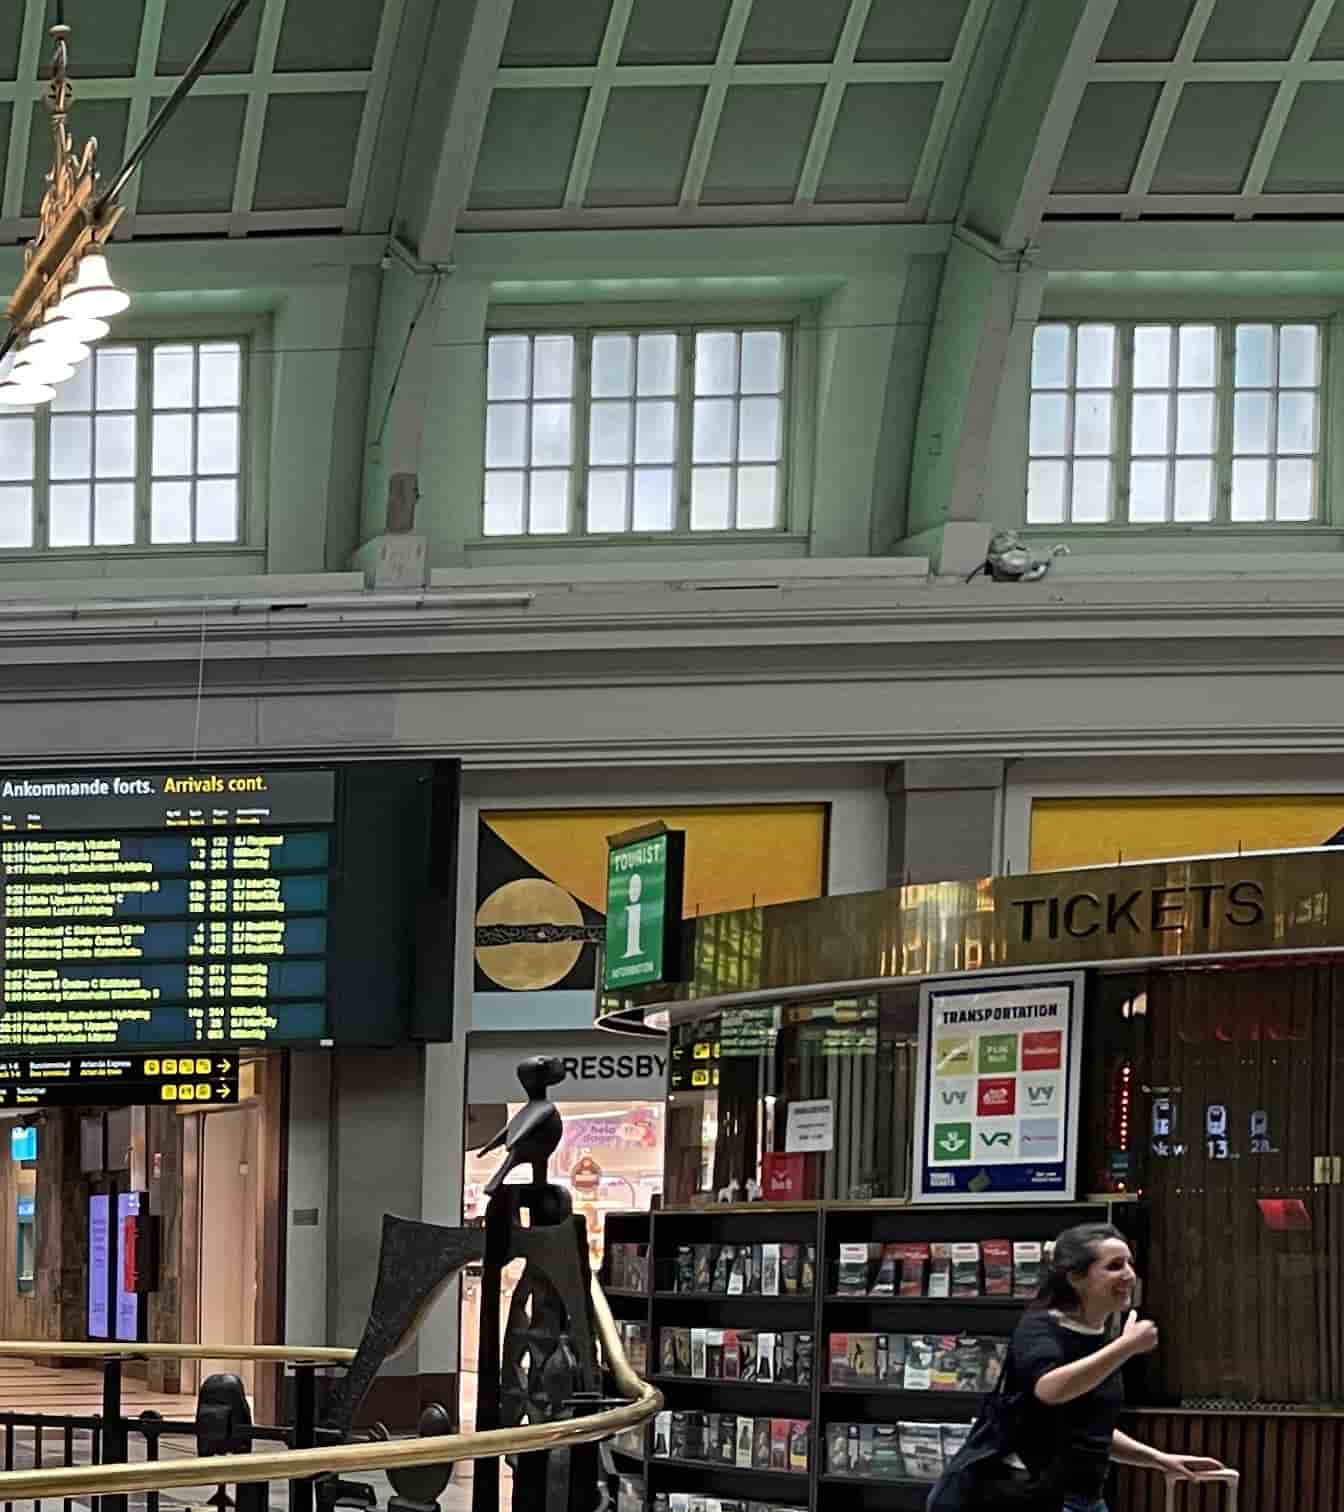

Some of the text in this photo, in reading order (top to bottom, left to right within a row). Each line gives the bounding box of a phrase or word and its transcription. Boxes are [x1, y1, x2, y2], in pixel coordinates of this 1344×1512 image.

[2, 776, 267, 798] Ankommande forts. Arrivals cont.
[615, 844, 660, 872] TOURIST
[1011, 881, 1265, 944] TICKETS
[943, 1003, 1058, 1025] TRANSPORTATION
[563, 1055, 667, 1079] RESSBY
[980, 1132, 1012, 1147] VR
